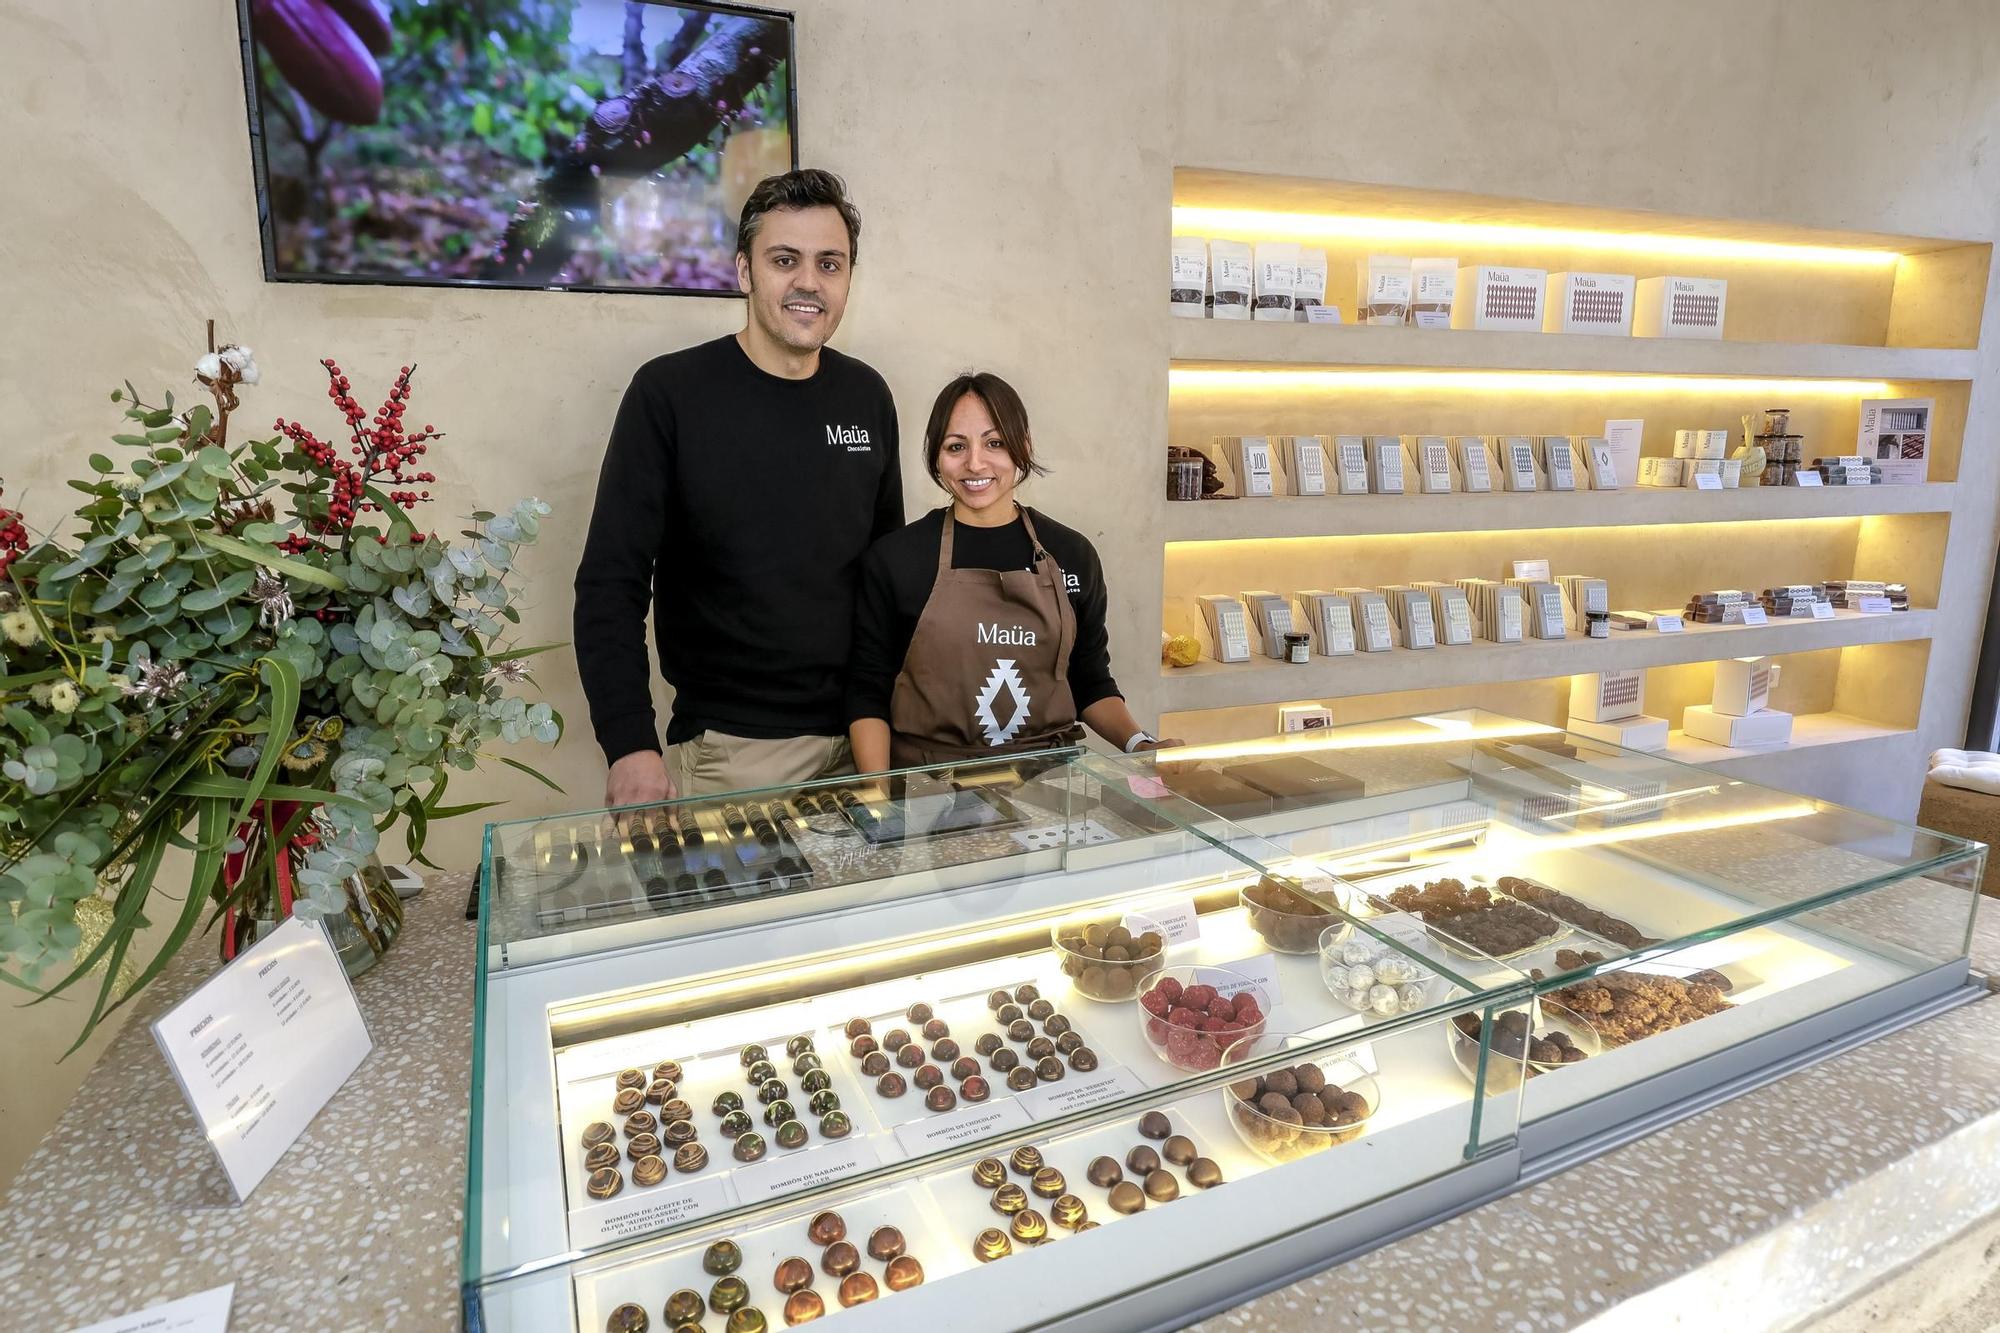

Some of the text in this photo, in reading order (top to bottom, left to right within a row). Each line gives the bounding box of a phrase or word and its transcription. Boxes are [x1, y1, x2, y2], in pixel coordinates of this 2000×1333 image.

[1487, 271, 1510, 282] Maüa
[1574, 277, 1597, 288] Maüa
[1674, 281, 1694, 292] Maüa
[1864, 408, 1877, 433] Maüa
[826, 424, 870, 445] Maüa
[1253, 452, 1267, 470] 100
[977, 622, 1036, 646] Maüa
[258, 959, 279, 979] PRECIOS
[189, 1014, 214, 1038] PRECIOS
[965, 1113, 1002, 1127] CHOCOLATE
[814, 1164, 846, 1178] NARANJA
[600, 1222, 625, 1234] OLIVA
[683, 1202, 700, 1212] CON
[604, 1197, 694, 1225] BOMBÓN DE ACEITE DE
[617, 1213, 686, 1236] GALLETA DE INCA
